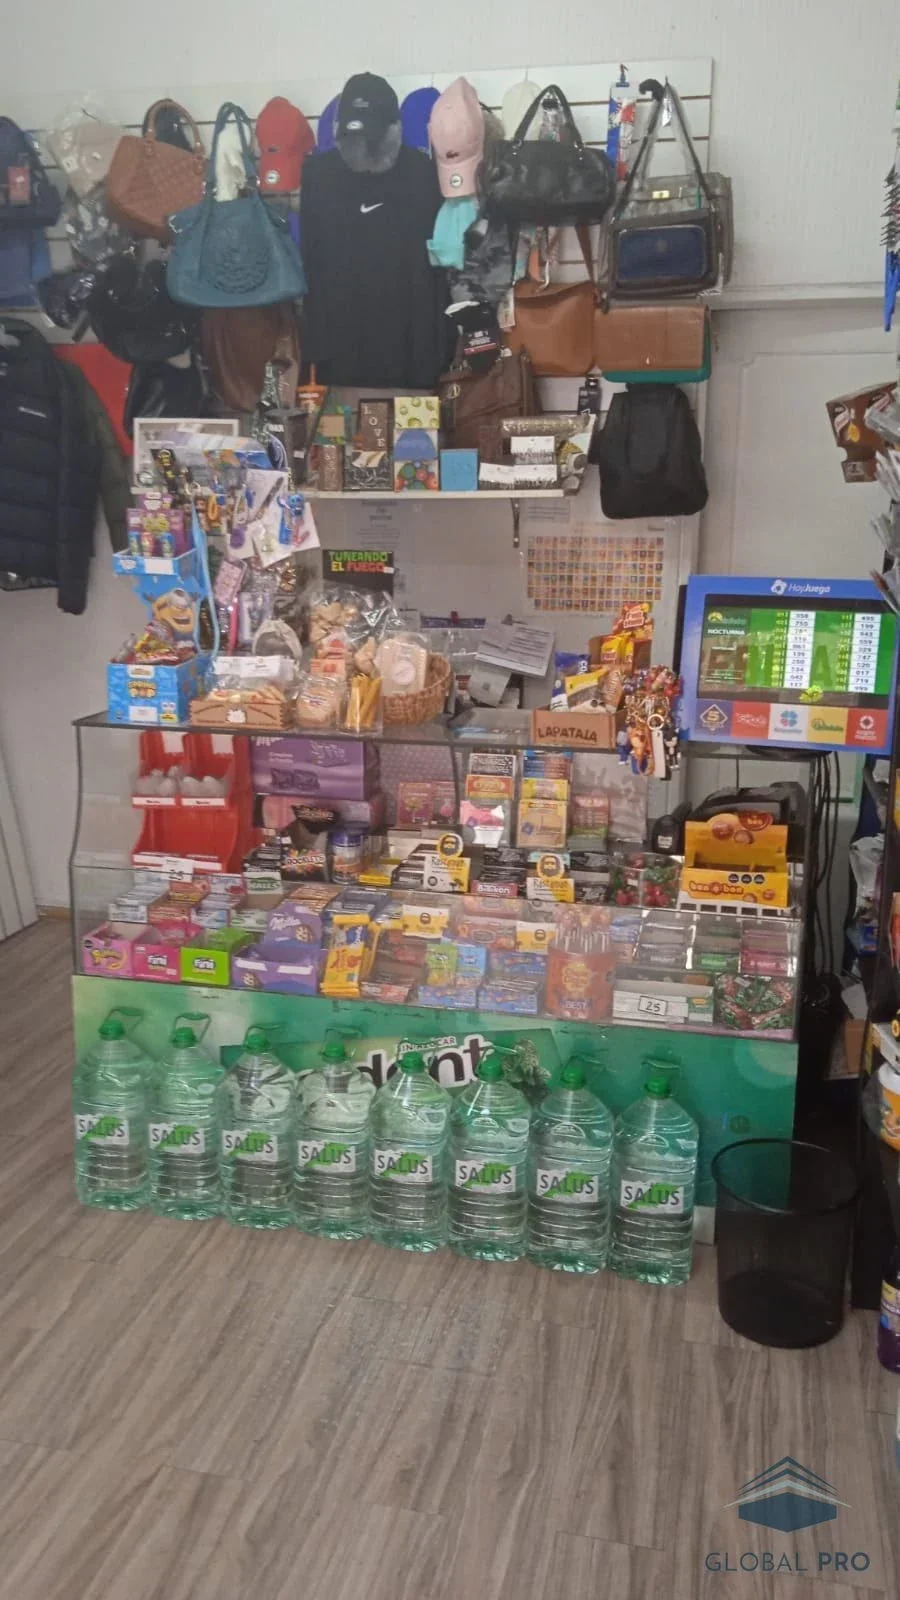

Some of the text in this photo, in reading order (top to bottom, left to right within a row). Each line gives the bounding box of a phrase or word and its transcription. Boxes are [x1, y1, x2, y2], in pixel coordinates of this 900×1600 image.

[361, 405, 386, 447] LOVE
[331, 561, 345, 572] EL
[646, 1001, 661, 1012] 25
[78, 1117, 126, 1138] SALUS
[151, 1127, 201, 1146] SALUS
[225, 1134, 274, 1154] SALUS
[301, 1145, 352, 1165] SALUS
[377, 1154, 429, 1175] SALUS
[459, 1165, 512, 1184] SALUS
[540, 1174, 594, 1195] SALUS
[624, 1185, 680, 1206] SALUS
